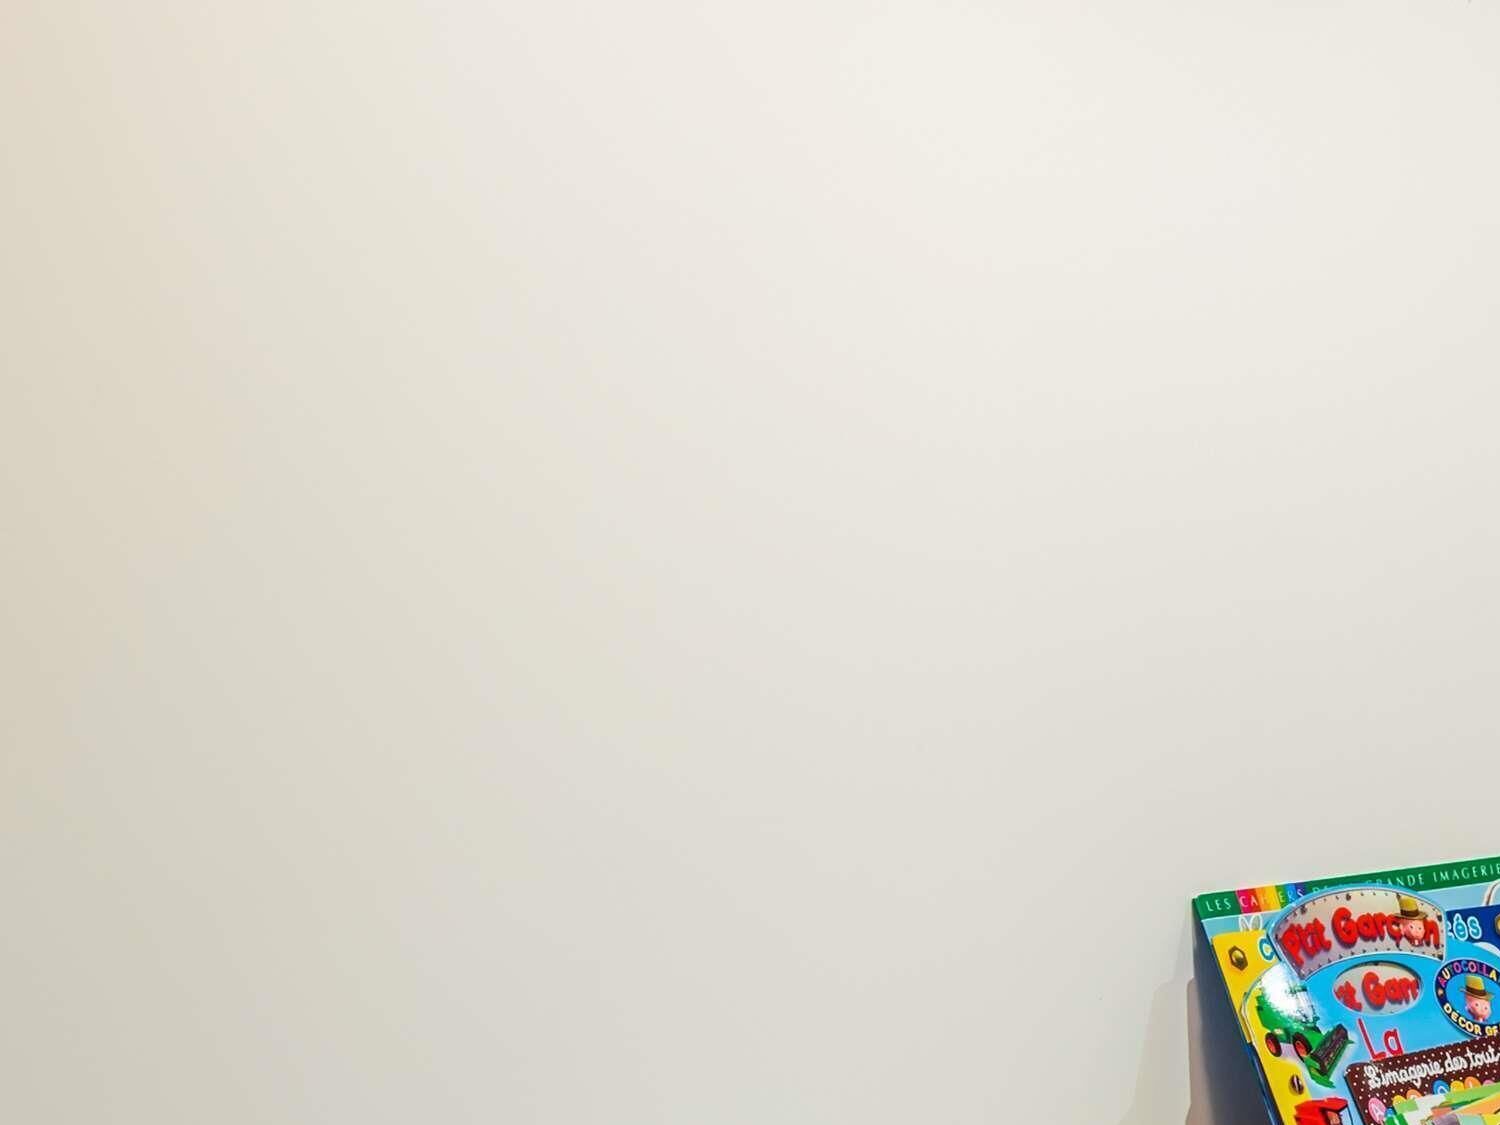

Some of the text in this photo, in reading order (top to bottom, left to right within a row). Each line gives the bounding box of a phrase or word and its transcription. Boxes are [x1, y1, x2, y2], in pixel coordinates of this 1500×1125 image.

[1205, 898, 1232, 912] LES
[1364, 873, 1425, 887] RANDE
[1358, 1017, 1405, 1061] La
[1444, 1050, 1470, 1073] des
